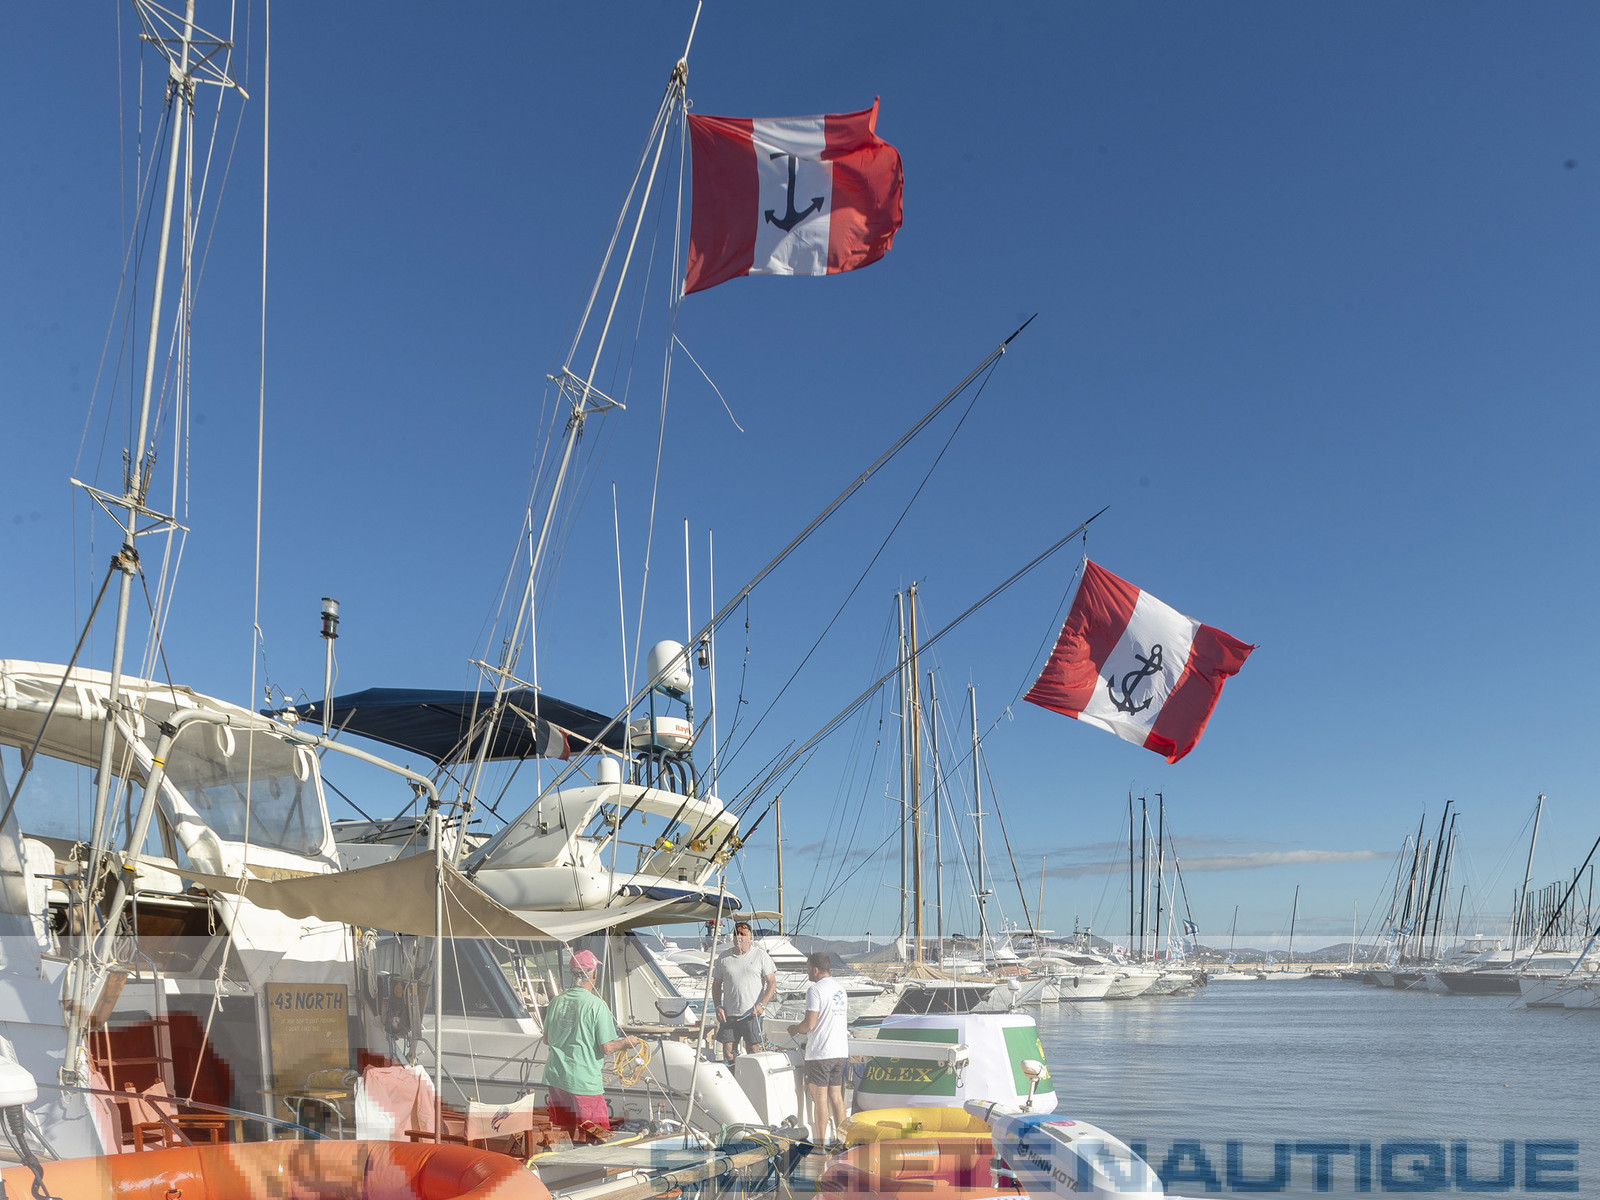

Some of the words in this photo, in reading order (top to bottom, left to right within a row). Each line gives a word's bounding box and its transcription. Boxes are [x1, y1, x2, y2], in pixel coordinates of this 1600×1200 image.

[274, 992, 292, 1010] 43
[295, 992, 343, 1010] NORTH
[866, 1066, 933, 1083] ROLEX
[1028, 1151, 1052, 1174] MINN
[1051, 1167, 1079, 1193] KOTA
